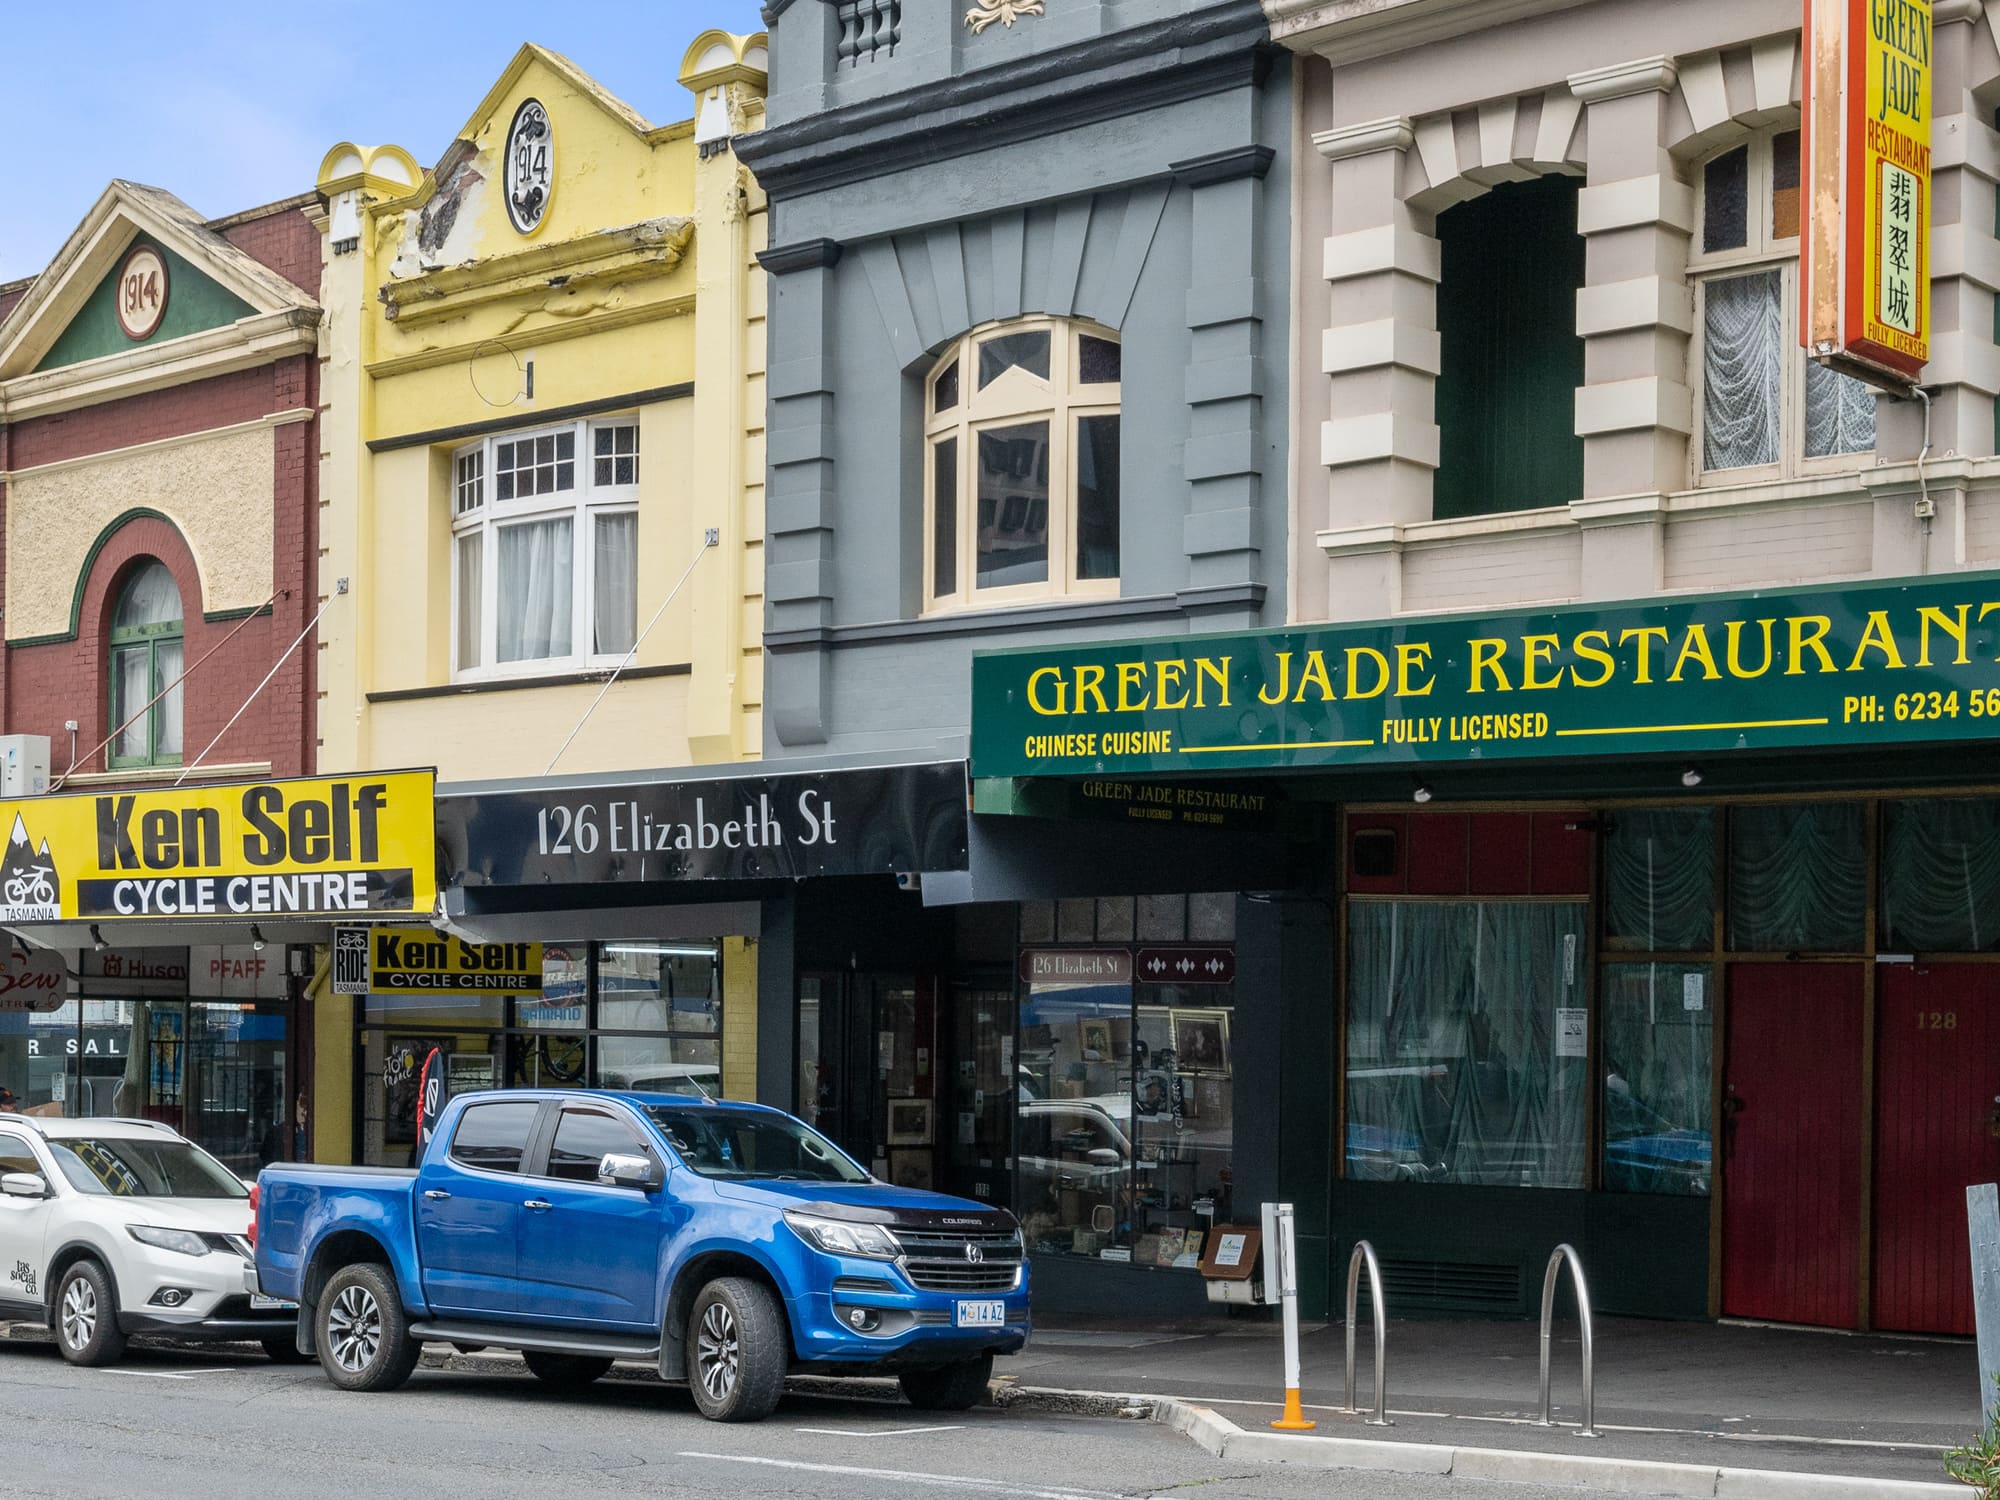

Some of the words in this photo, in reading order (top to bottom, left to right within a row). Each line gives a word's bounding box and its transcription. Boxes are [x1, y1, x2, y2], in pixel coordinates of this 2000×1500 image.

[1872, 0, 1930, 67] GREEN
[1879, 50, 1921, 122] JADE
[1868, 117, 1932, 177] RESTAURANT
[514, 144, 547, 191] 1914
[1887, 172, 1911, 328] 翡翠城
[125, 270, 158, 314] 1914
[1868, 322, 1889, 345] FULLY
[1893, 332, 1927, 360] LICENSED
[1026, 656, 1232, 715] GREEN
[1258, 642, 1437, 705] JADE
[1844, 695, 1885, 723] PH:
[1894, 690, 1960, 720] 6234
[1025, 733, 1097, 758] CHINESE
[1102, 730, 1171, 755] CUISINE
[1382, 717, 1441, 744] FULLY
[1450, 712, 1548, 741] LICENSED
[1083, 781, 1133, 800] GREEN
[1137, 786, 1172, 804] JADE
[1177, 789, 1265, 811] RESTAURANT
[96, 795, 221, 870] Ken
[241, 783, 387, 866] Self
[538, 804, 599, 855] 126
[609, 793, 782, 852] Elizabeth
[798, 789, 837, 846] St
[113, 878, 216, 915] CYCLE
[226, 872, 369, 913] CENTRE
[5, 907, 55, 921] TASMANIA
[210, 959, 266, 978] PFAFF
[336, 949, 368, 983] RIDE
[377, 935, 448, 969] Ken
[460, 942, 530, 971] Self
[1033, 957, 1051, 973] 126
[1055, 956, 1102, 974] Elizabeth
[1106, 956, 1118, 973] St
[336, 983, 369, 993] TASMANIA
[390, 974, 450, 987] CYCLE
[459, 975, 527, 988] CENTRE
[1919, 1011, 1956, 1029] 128
[10, 1269, 36, 1285] social
[17, 1260, 30, 1274] tas
